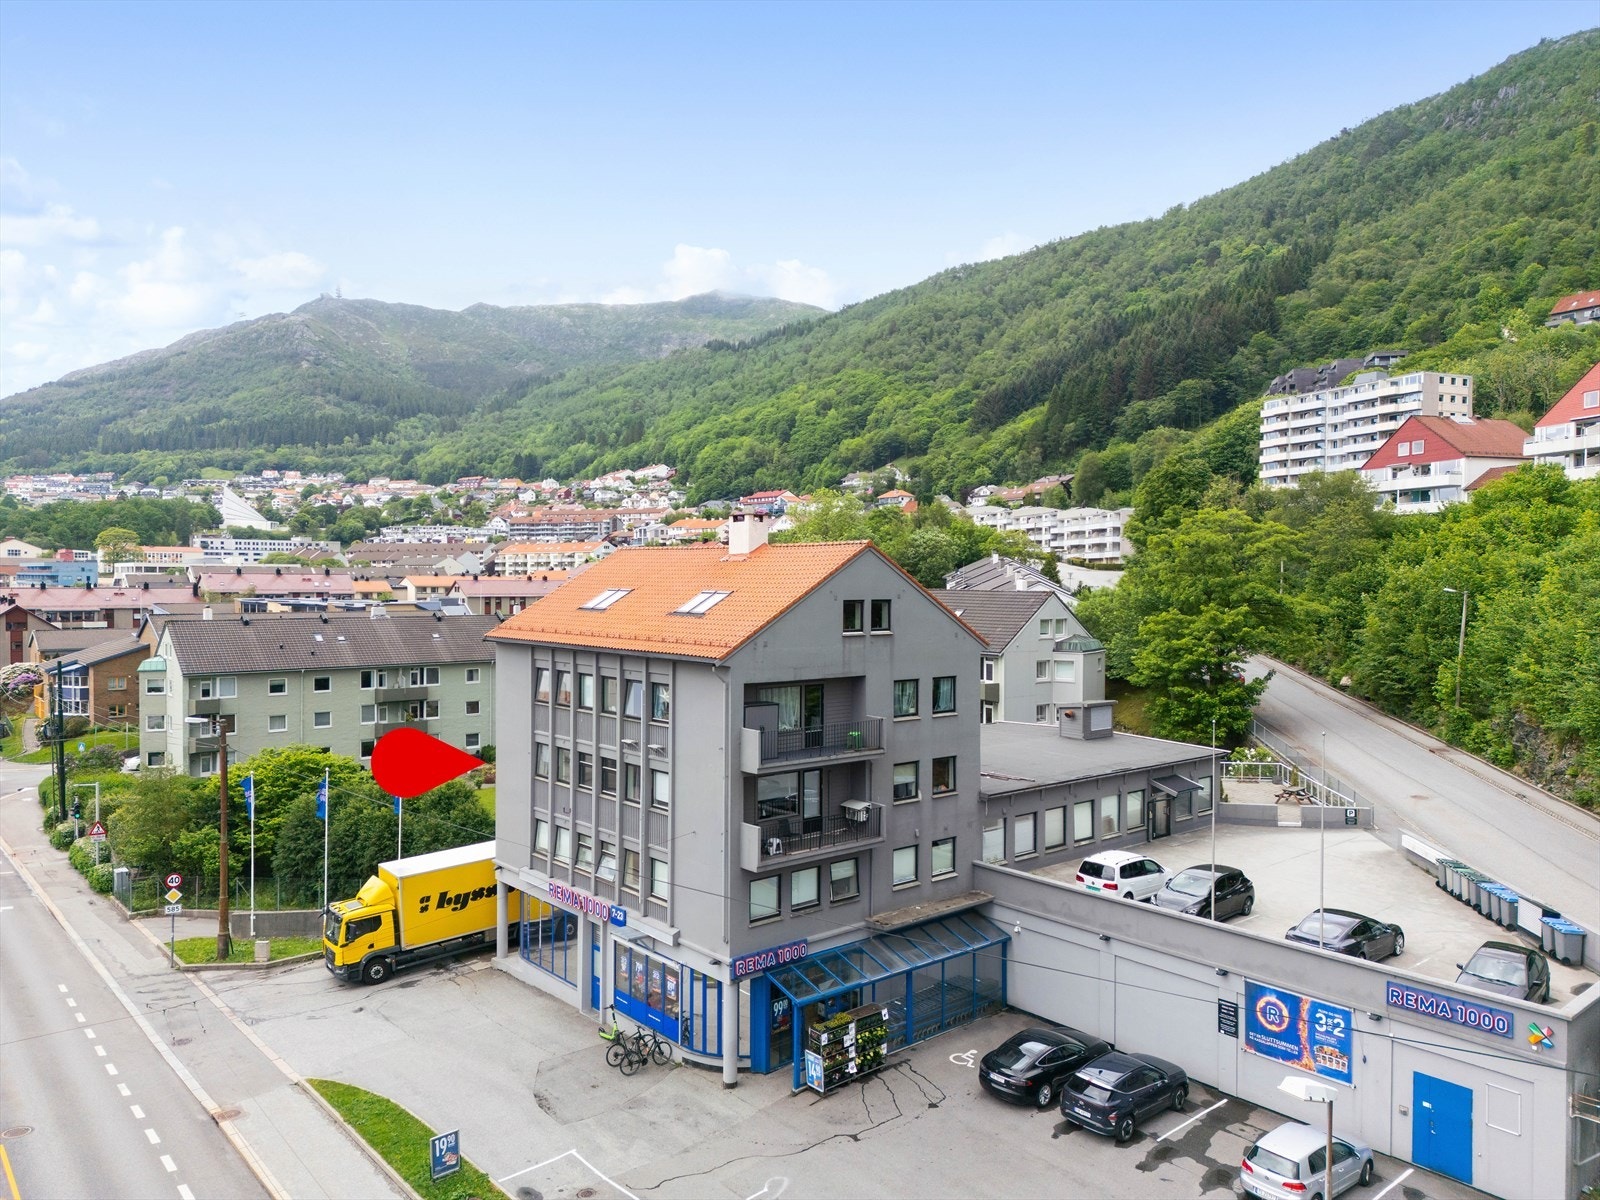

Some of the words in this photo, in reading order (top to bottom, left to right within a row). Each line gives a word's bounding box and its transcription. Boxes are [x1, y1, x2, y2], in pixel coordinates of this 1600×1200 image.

[168, 876, 180, 884] 40
[435, 883, 516, 911] byss
[548, 882, 581, 910] REMA
[582, 895, 608, 921] 1000
[166, 905, 180, 913] 585
[611, 908, 624, 920] 7-23
[735, 952, 776, 976] REMA
[777, 943, 807, 964] 1000
[773, 1001, 783, 1016] 99
[1266, 1005, 1280, 1023] R
[1389, 987, 1452, 1018] REMA
[1456, 1005, 1508, 1033] 1000
[1314, 1012, 1327, 1032] 3
[1333, 1017, 1345, 1038] 2
[1261, 1034, 1299, 1051] SLUTTSUMMEN
[808, 1060, 817, 1080] 14
[434, 1137, 447, 1157] 19
[447, 1134, 455, 1143] 90
